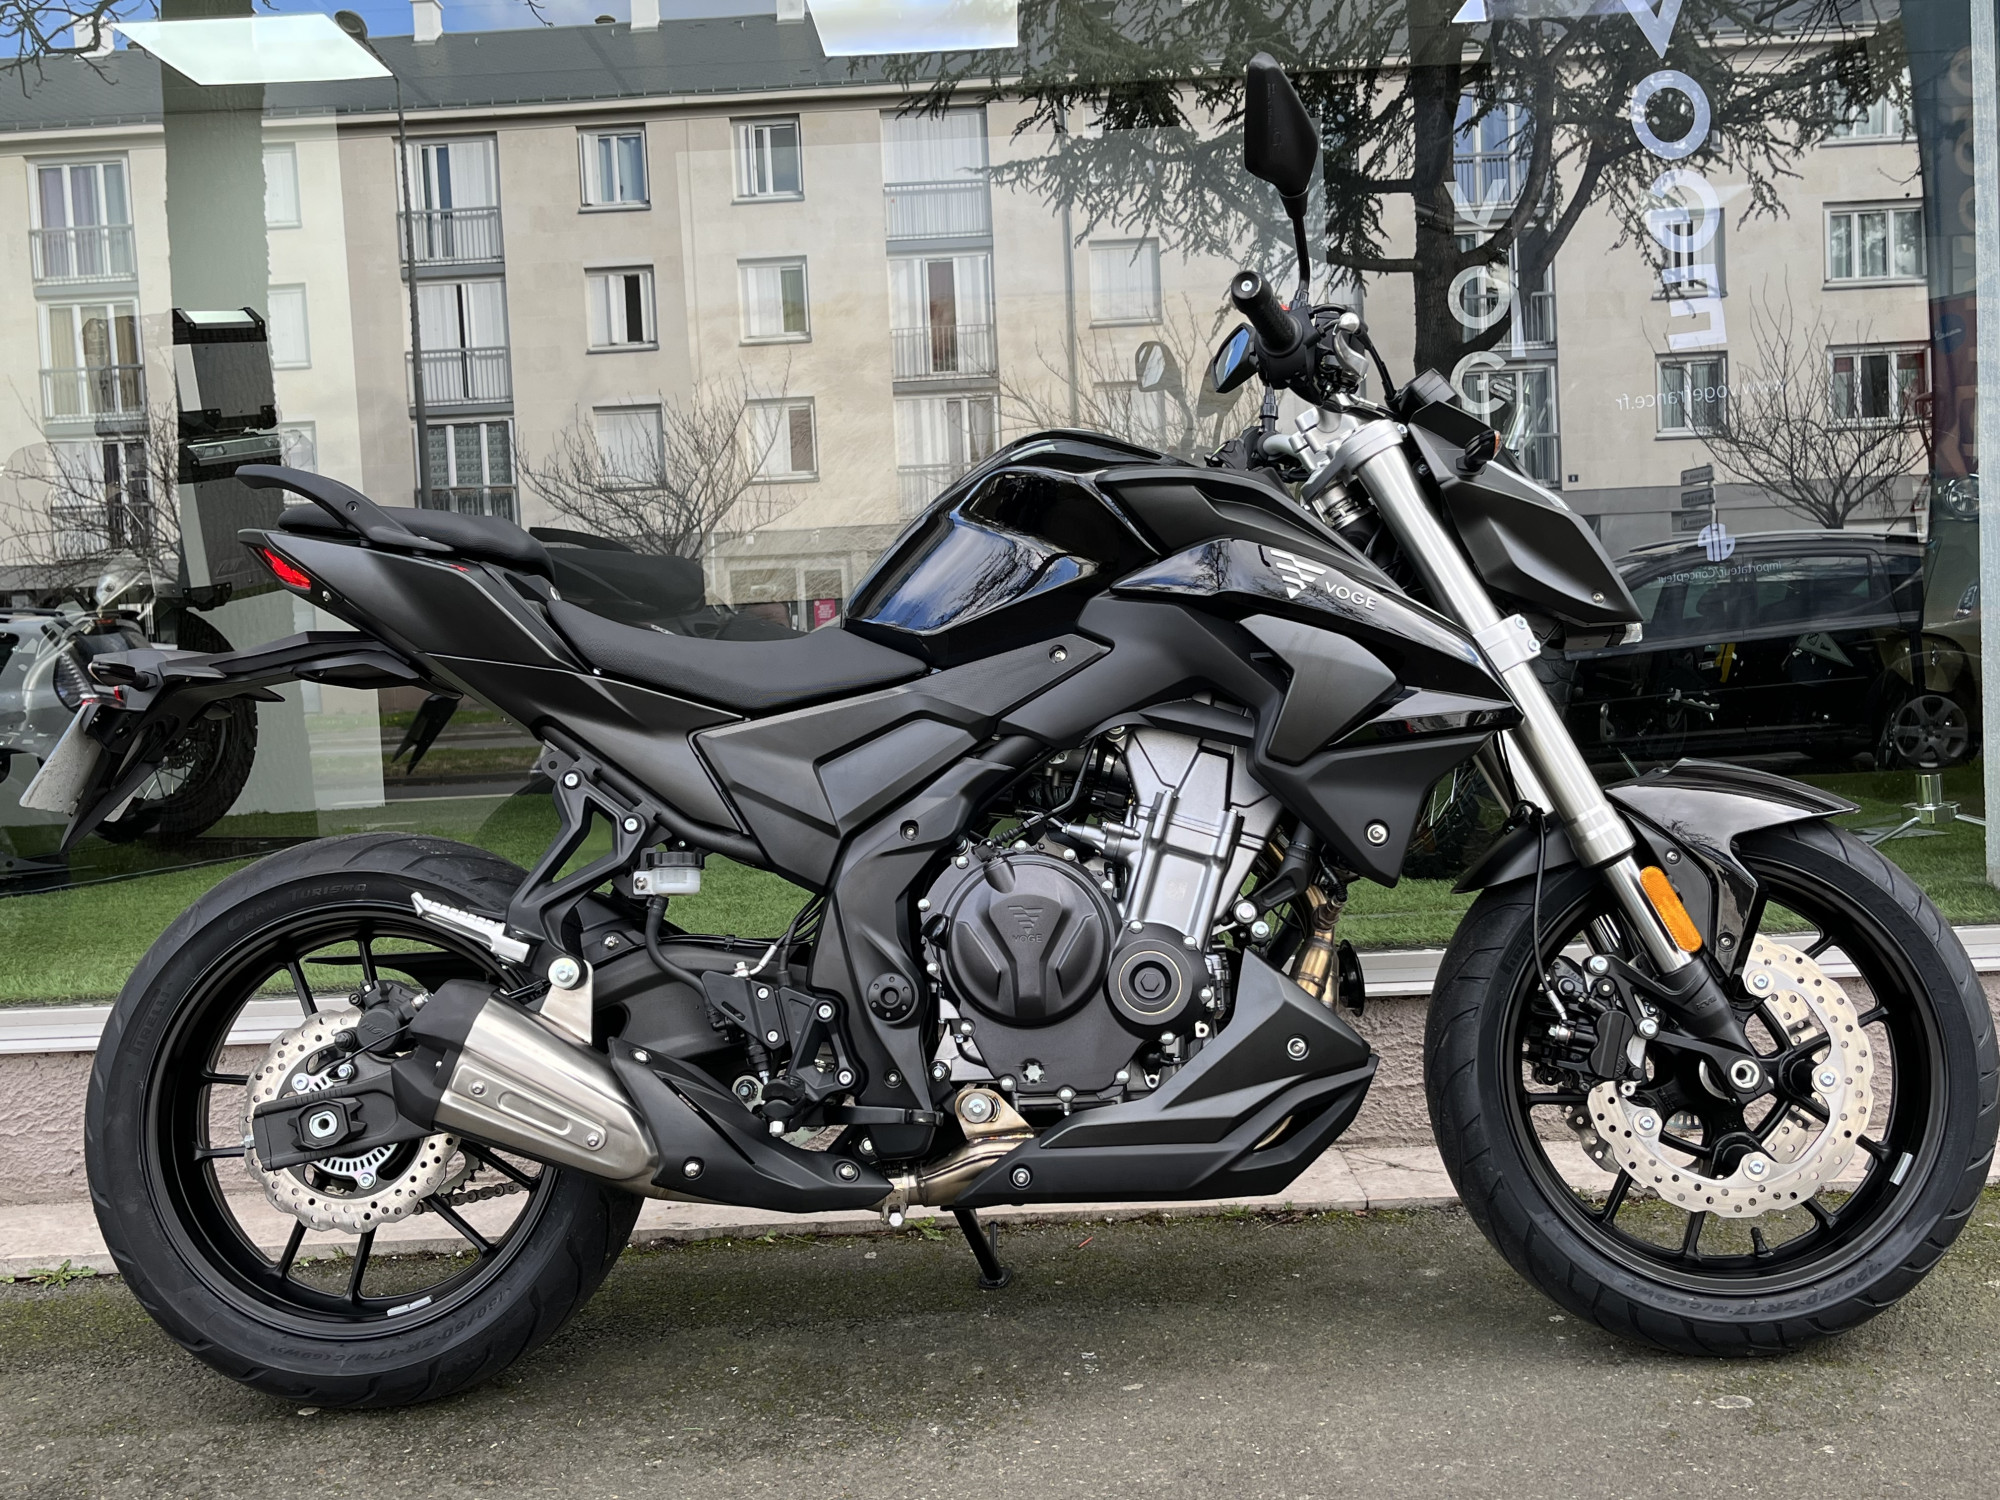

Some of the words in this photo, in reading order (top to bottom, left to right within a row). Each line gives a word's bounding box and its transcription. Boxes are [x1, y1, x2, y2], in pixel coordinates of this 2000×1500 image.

[1325, 581, 1377, 611] VOGE
[288, 883, 367, 901] TURISMO
[1011, 933, 1043, 943] VOGE
[125, 987, 170, 1057] PIRELLI
